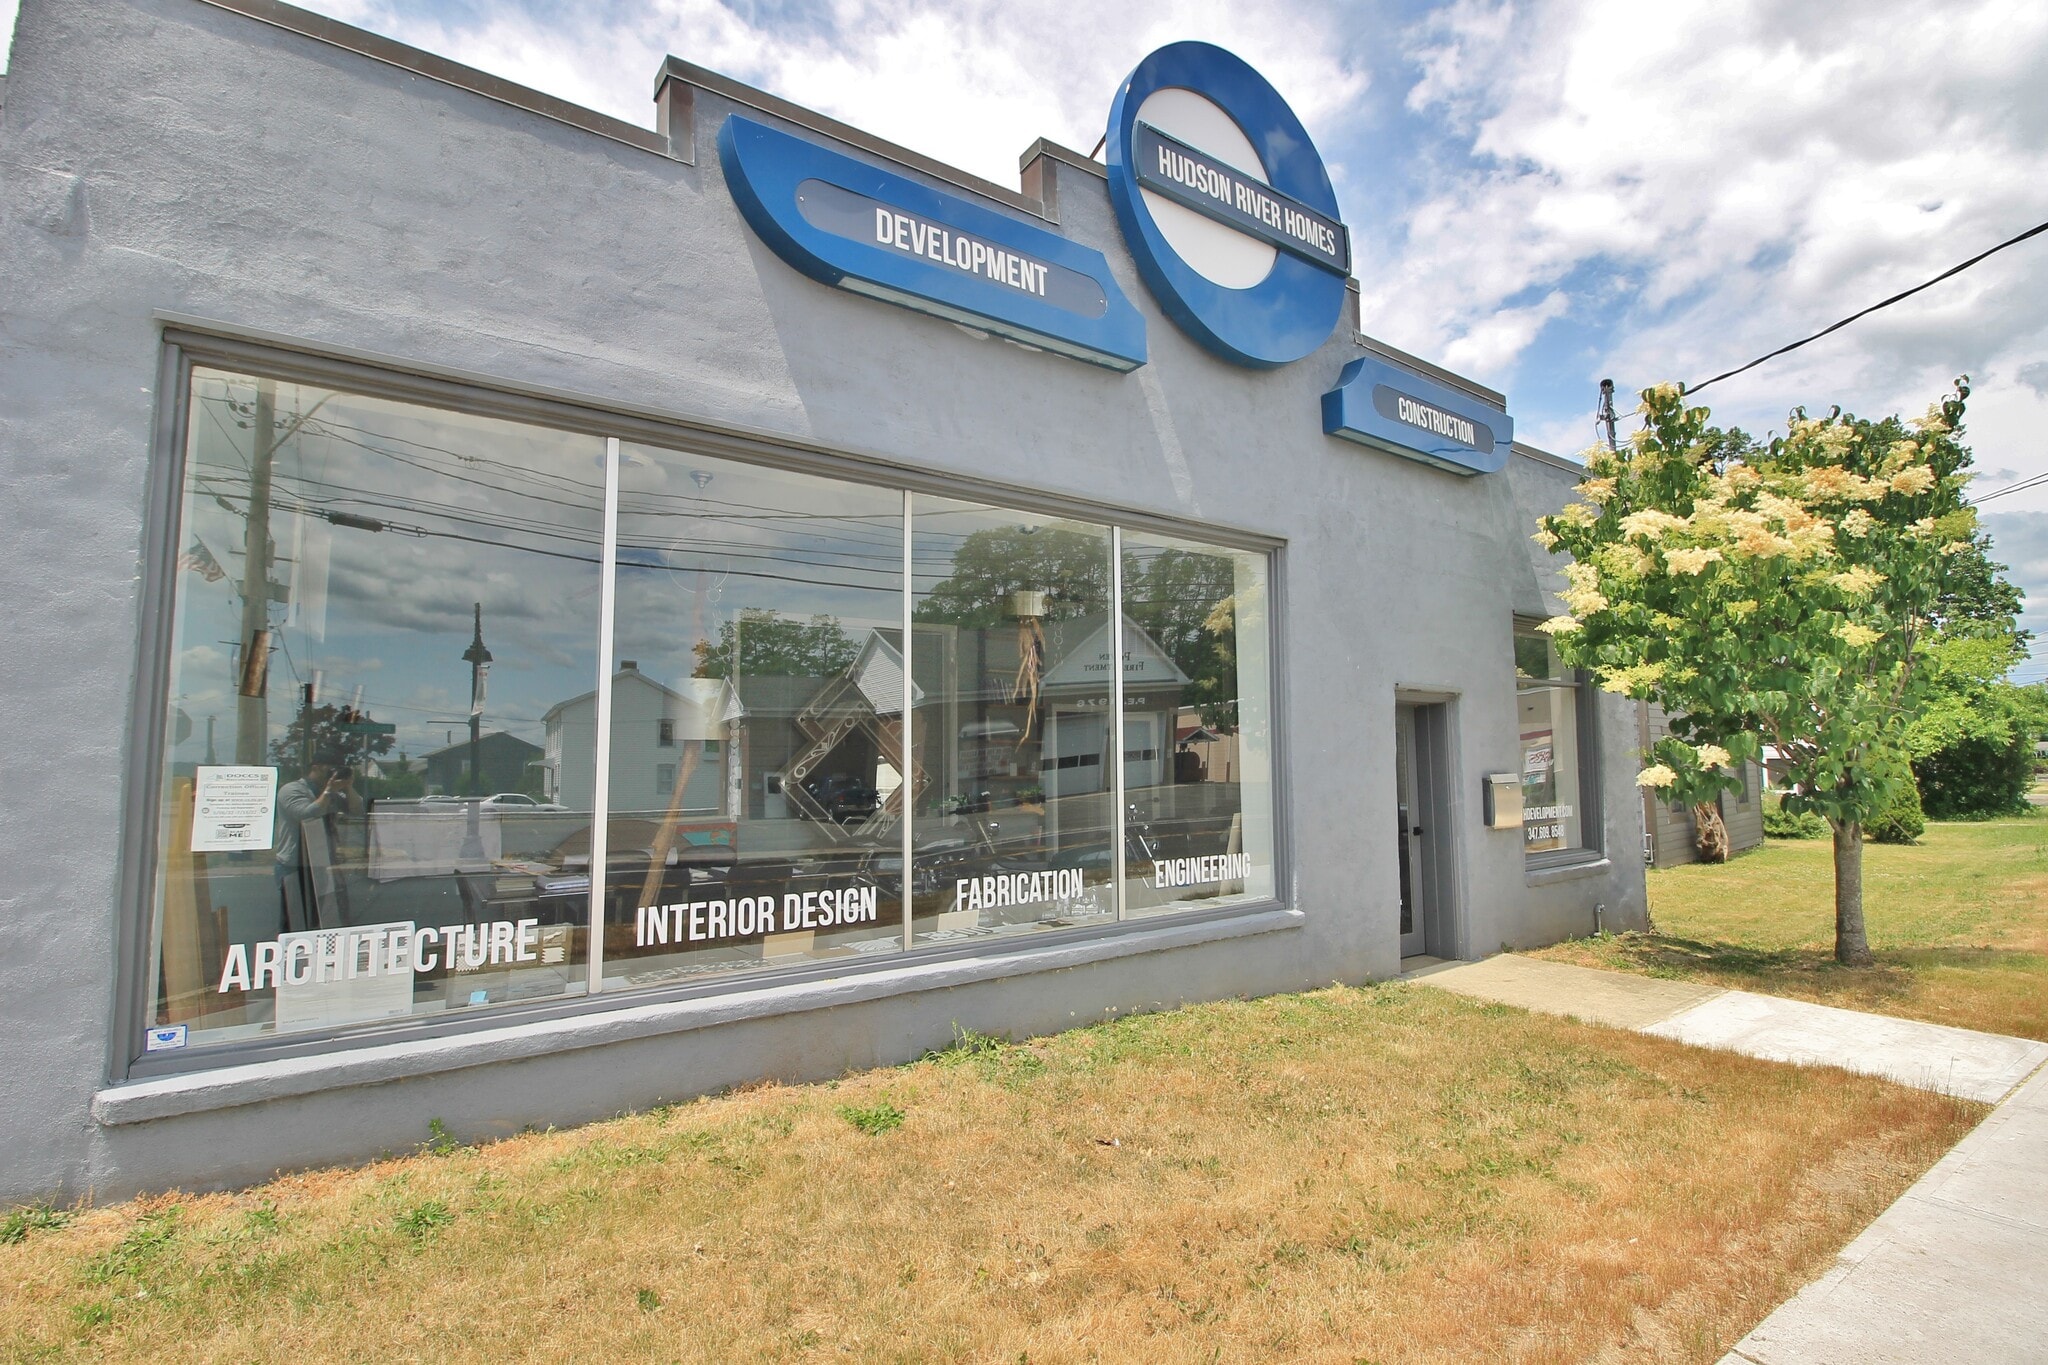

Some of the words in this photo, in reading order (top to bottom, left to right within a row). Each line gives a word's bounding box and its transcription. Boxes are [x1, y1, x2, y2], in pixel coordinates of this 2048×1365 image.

[1158, 145, 1232, 206] HUDSON
[1235, 181, 1282, 231] RIVER
[1284, 207, 1336, 257] HOMES
[876, 207, 1047, 296] DEVELOPMENT
[1398, 397, 1475, 445] CONSTRUCTION
[956, 868, 1083, 912] FABRICATION
[1154, 852, 1251, 889] ENGINEERING
[636, 894, 775, 947] INTERIOR
[783, 886, 877, 931] DESIGN
[218, 918, 539, 994] ARCHITECTURE
